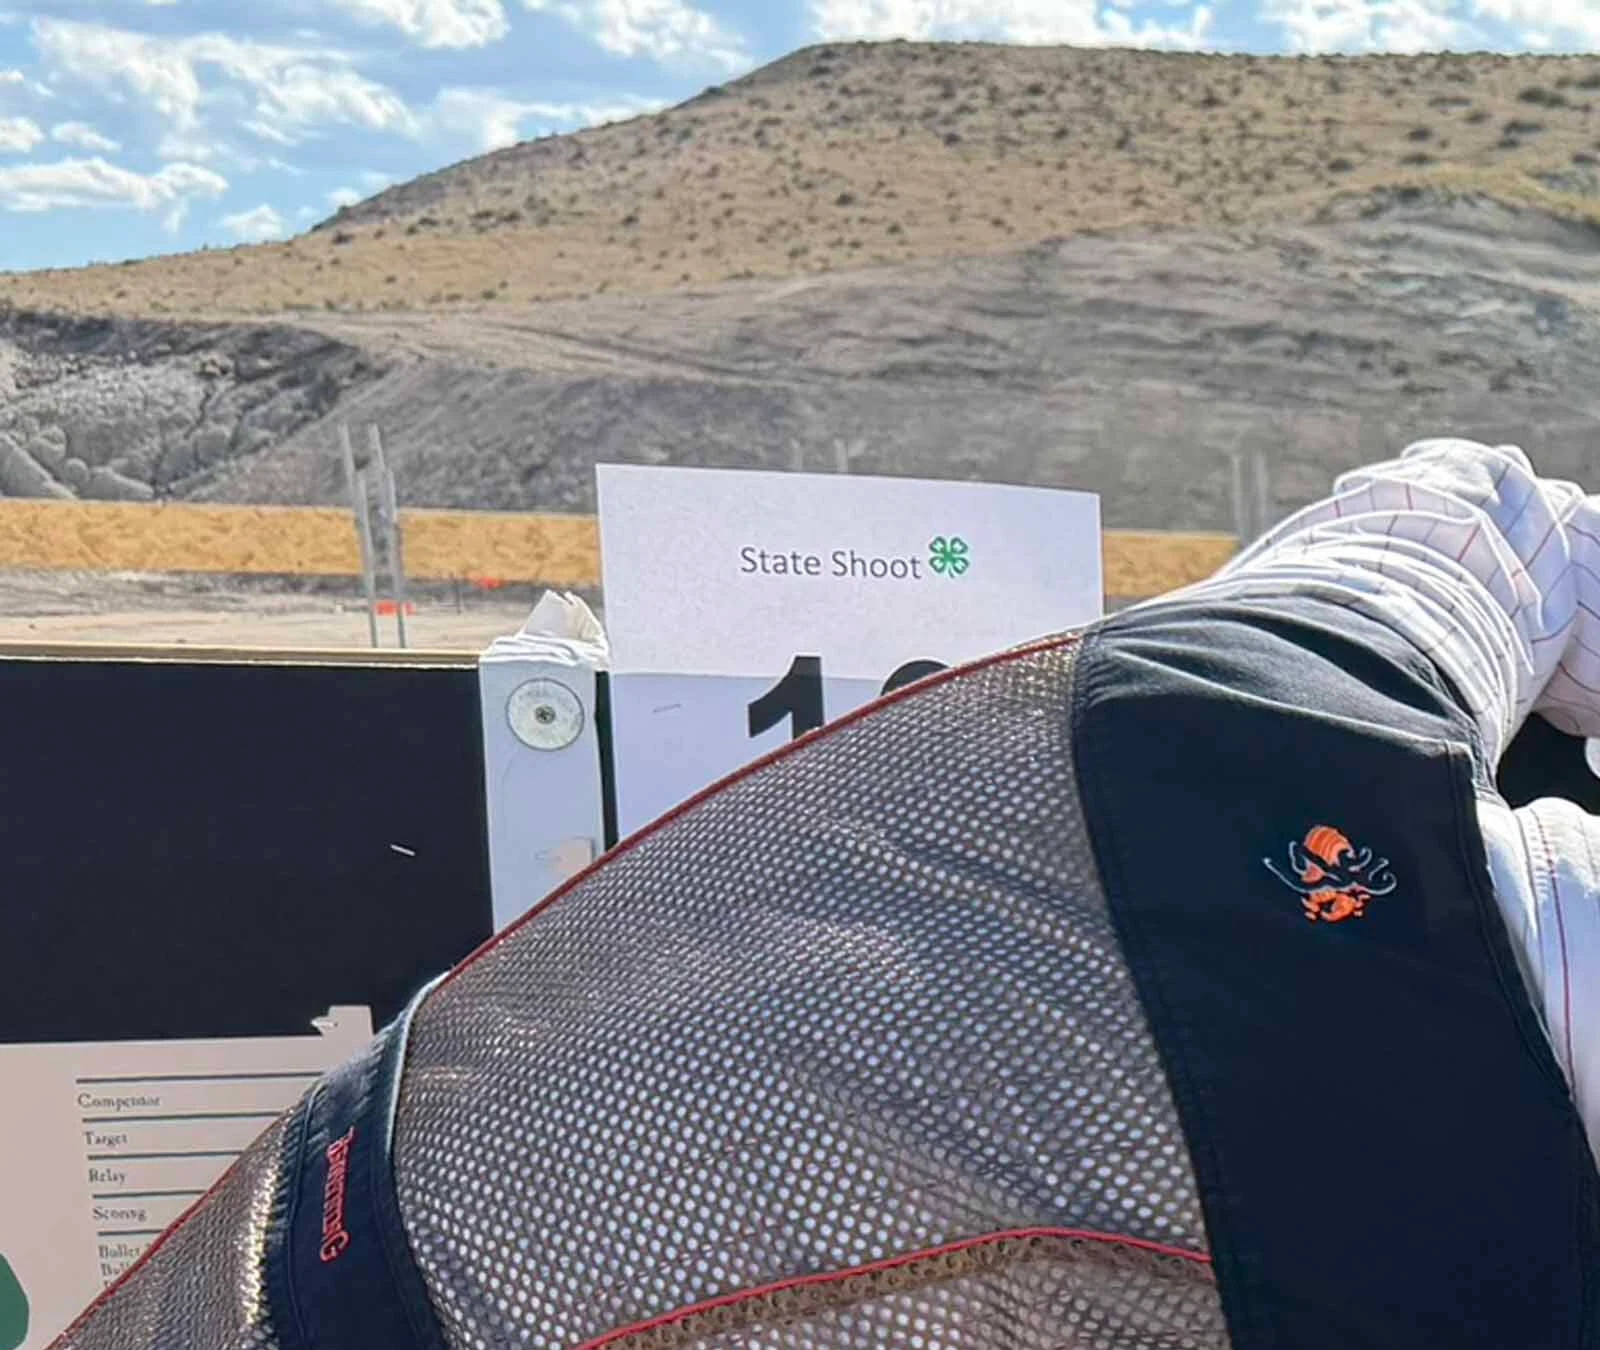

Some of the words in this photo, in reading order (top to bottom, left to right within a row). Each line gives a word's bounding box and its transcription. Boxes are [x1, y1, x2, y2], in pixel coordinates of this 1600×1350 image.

[741, 547, 821, 577] State
[831, 550, 922, 579] Shoot
[747, 655, 950, 739] 1
[77, 1092, 160, 1111] Competitor
[84, 1131, 127, 1146] Target
[88, 1168, 126, 1185] Relay
[92, 1206, 146, 1222] Scoring
